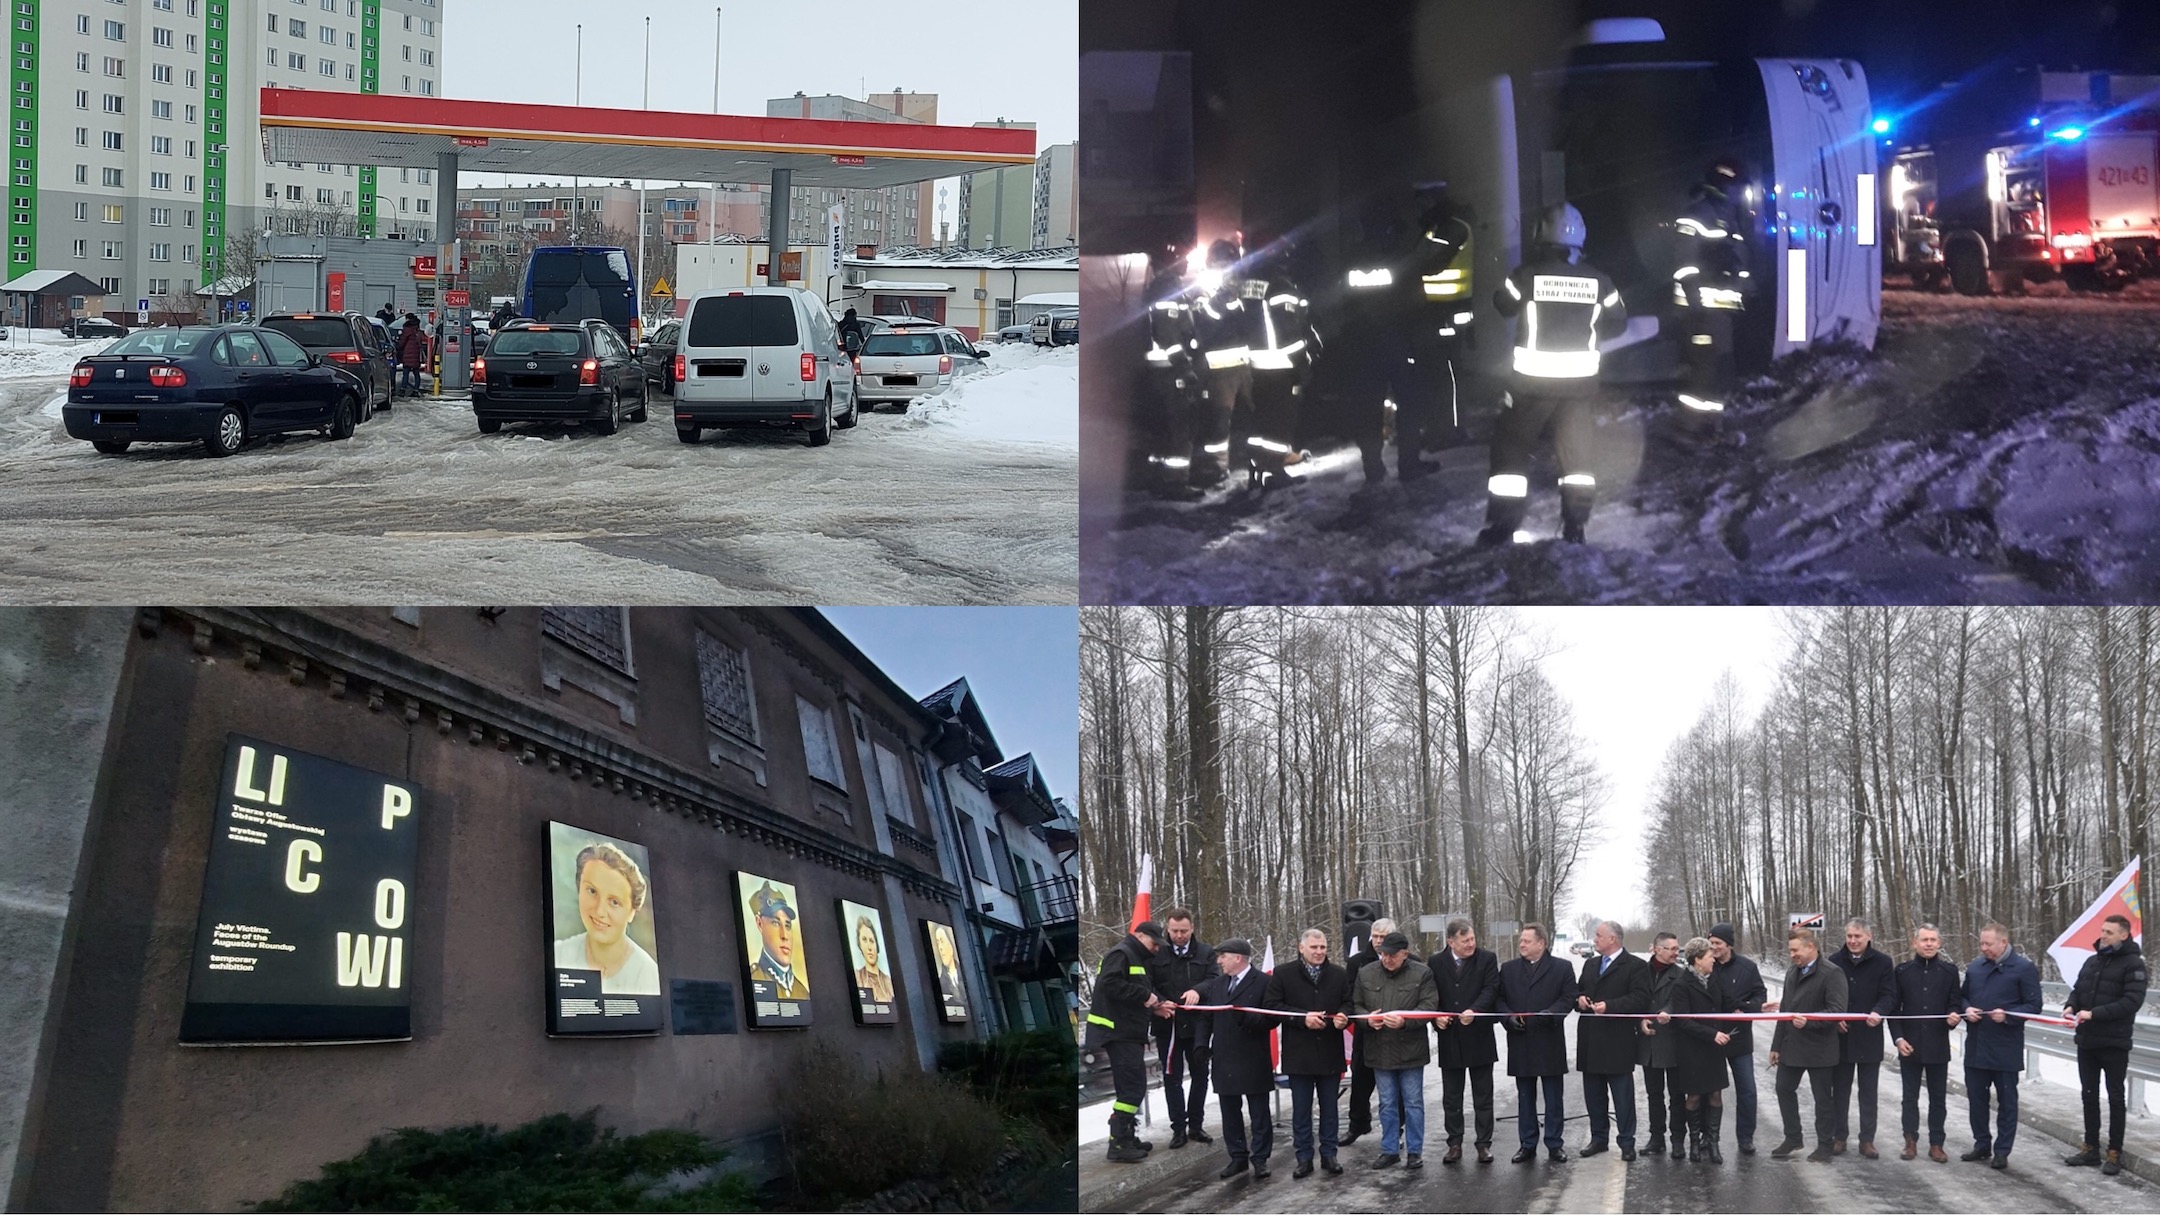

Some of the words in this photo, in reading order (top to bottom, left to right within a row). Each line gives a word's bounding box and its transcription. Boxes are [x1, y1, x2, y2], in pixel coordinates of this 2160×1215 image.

[759, 266, 766, 274] 3
[451, 296, 466, 304] 24H
[233, 745, 289, 806] LI
[231, 803, 265, 817] Twarze
[265, 811, 288, 821] Ofiar
[381, 783, 413, 830] P
[229, 826, 268, 839] wystawa
[266, 818, 326, 837] Augustowskiej
[227, 833, 267, 846] czasowa
[285, 838, 323, 894] C
[375, 878, 406, 930] O
[215, 922, 236, 933] July
[235, 924, 272, 935] Victims.
[213, 930, 241, 940] Faces
[241, 933, 253, 941] of
[252, 933, 268, 942] the
[212, 938, 258, 948] Augustów
[258, 941, 297, 952] Roundup
[209, 954, 258, 966] temporary
[337, 931, 403, 989] WI
[208, 962, 255, 972] exhibition
